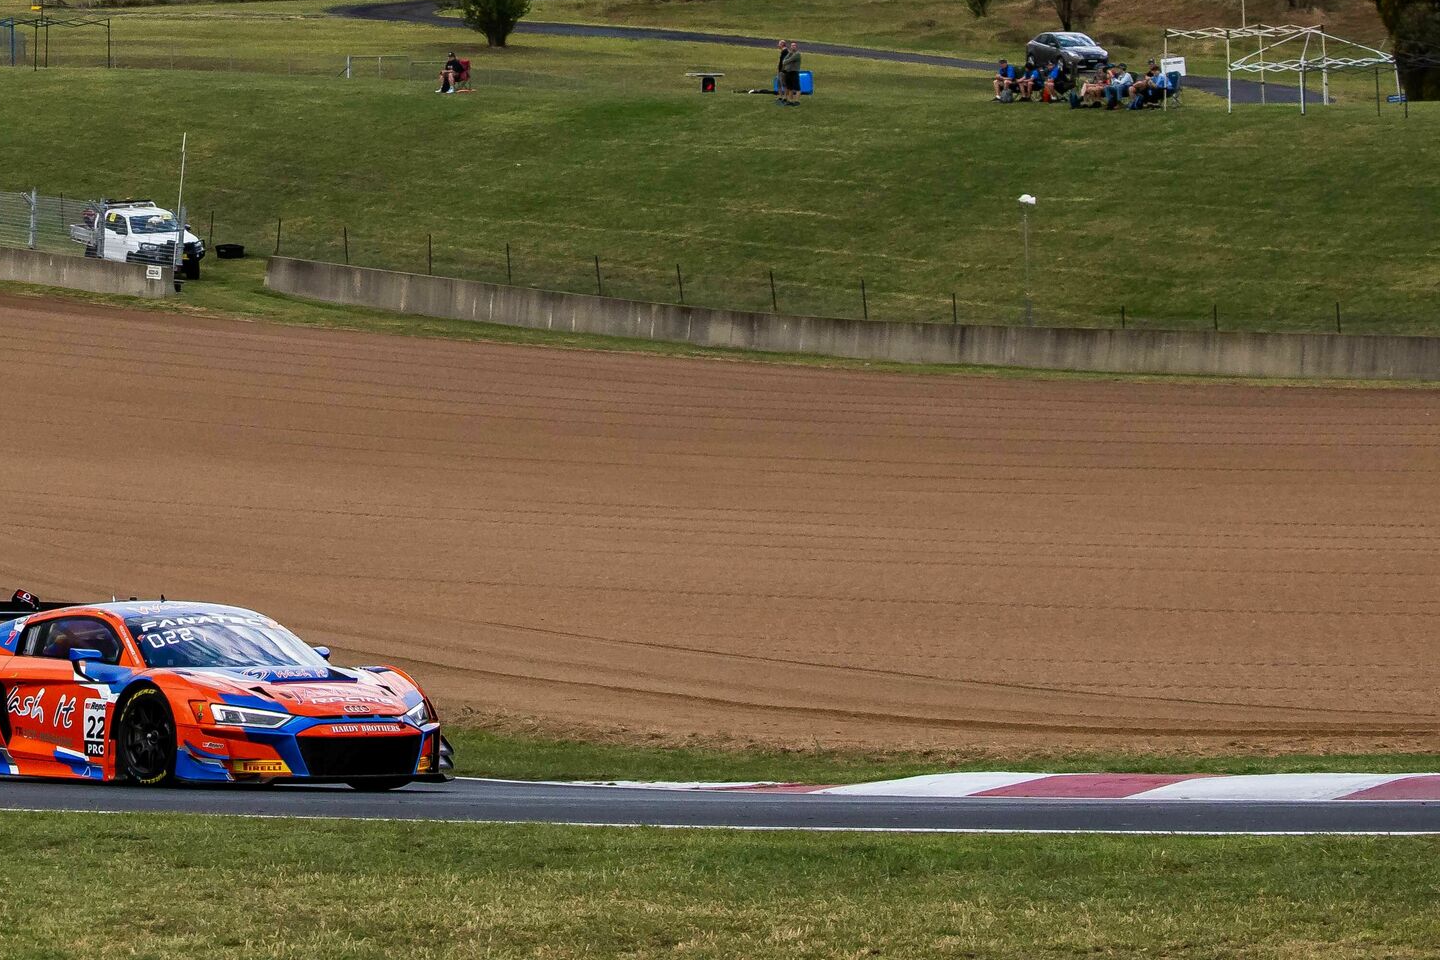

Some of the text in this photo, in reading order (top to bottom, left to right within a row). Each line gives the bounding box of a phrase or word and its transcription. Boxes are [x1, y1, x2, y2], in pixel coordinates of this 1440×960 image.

[140, 615, 263, 632] FANATEC
[147, 627, 195, 649] 022
[311, 696, 393, 705] RACING
[53, 692, 77, 729] It
[86, 715, 105, 739] 22
[332, 724, 401, 733] HARDY BROTHERS
[87, 743, 104, 755] PRO
[243, 761, 283, 771] PIRELLI
